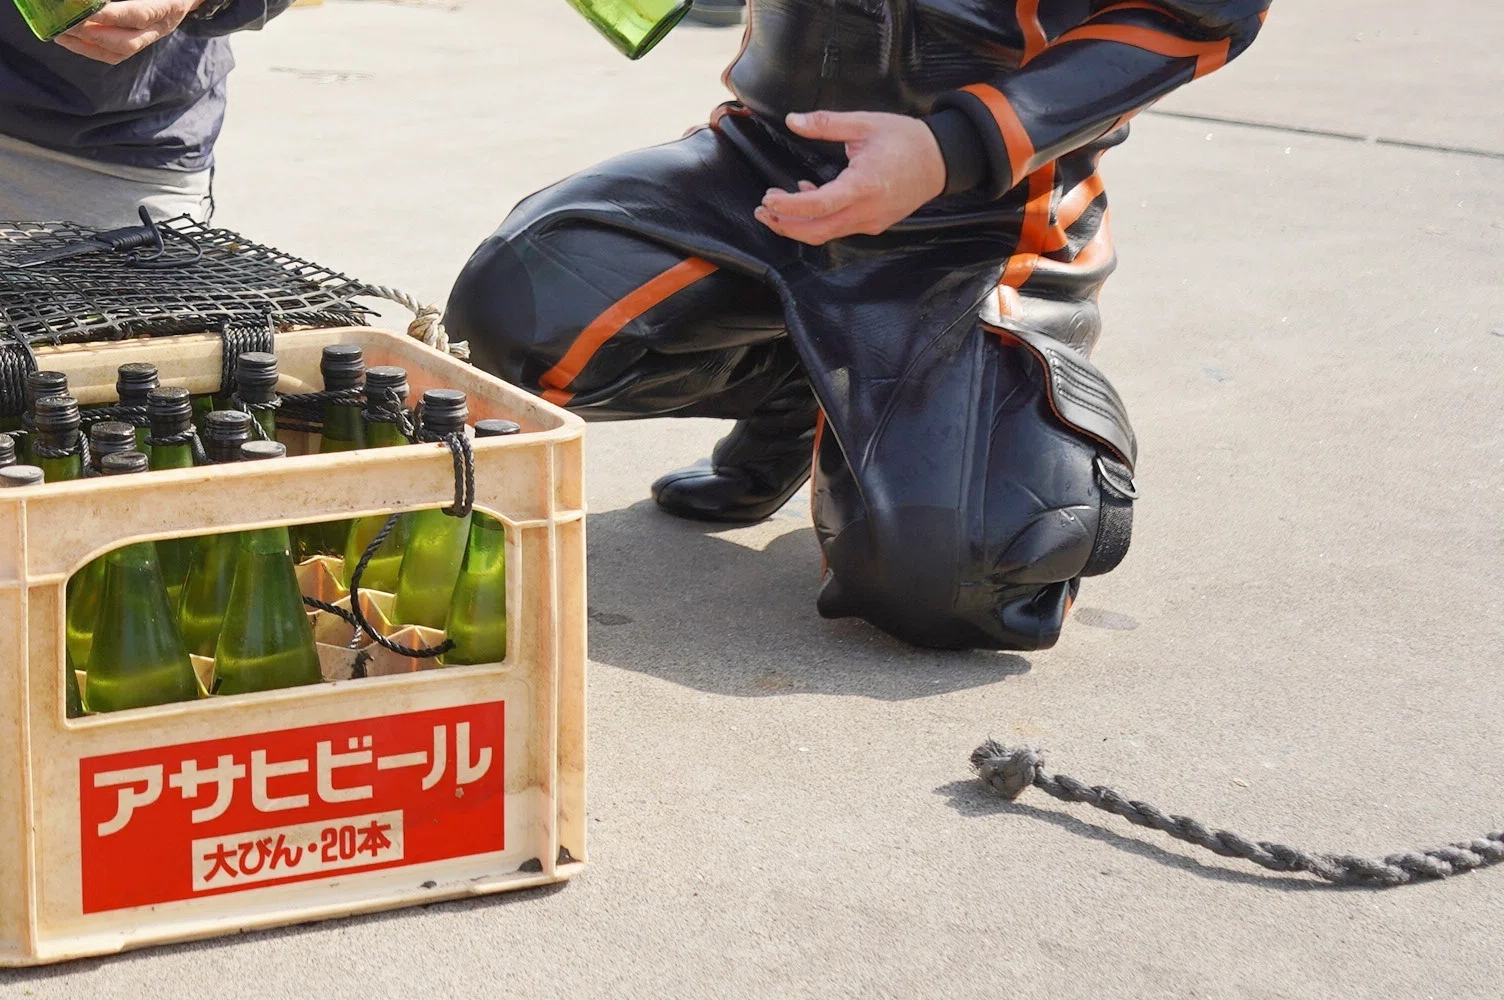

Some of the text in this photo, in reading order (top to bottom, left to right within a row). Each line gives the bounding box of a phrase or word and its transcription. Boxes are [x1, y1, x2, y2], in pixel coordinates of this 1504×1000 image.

[94, 721, 493, 837] アサヒビール
[202, 820, 392, 882] 大びん・20本
